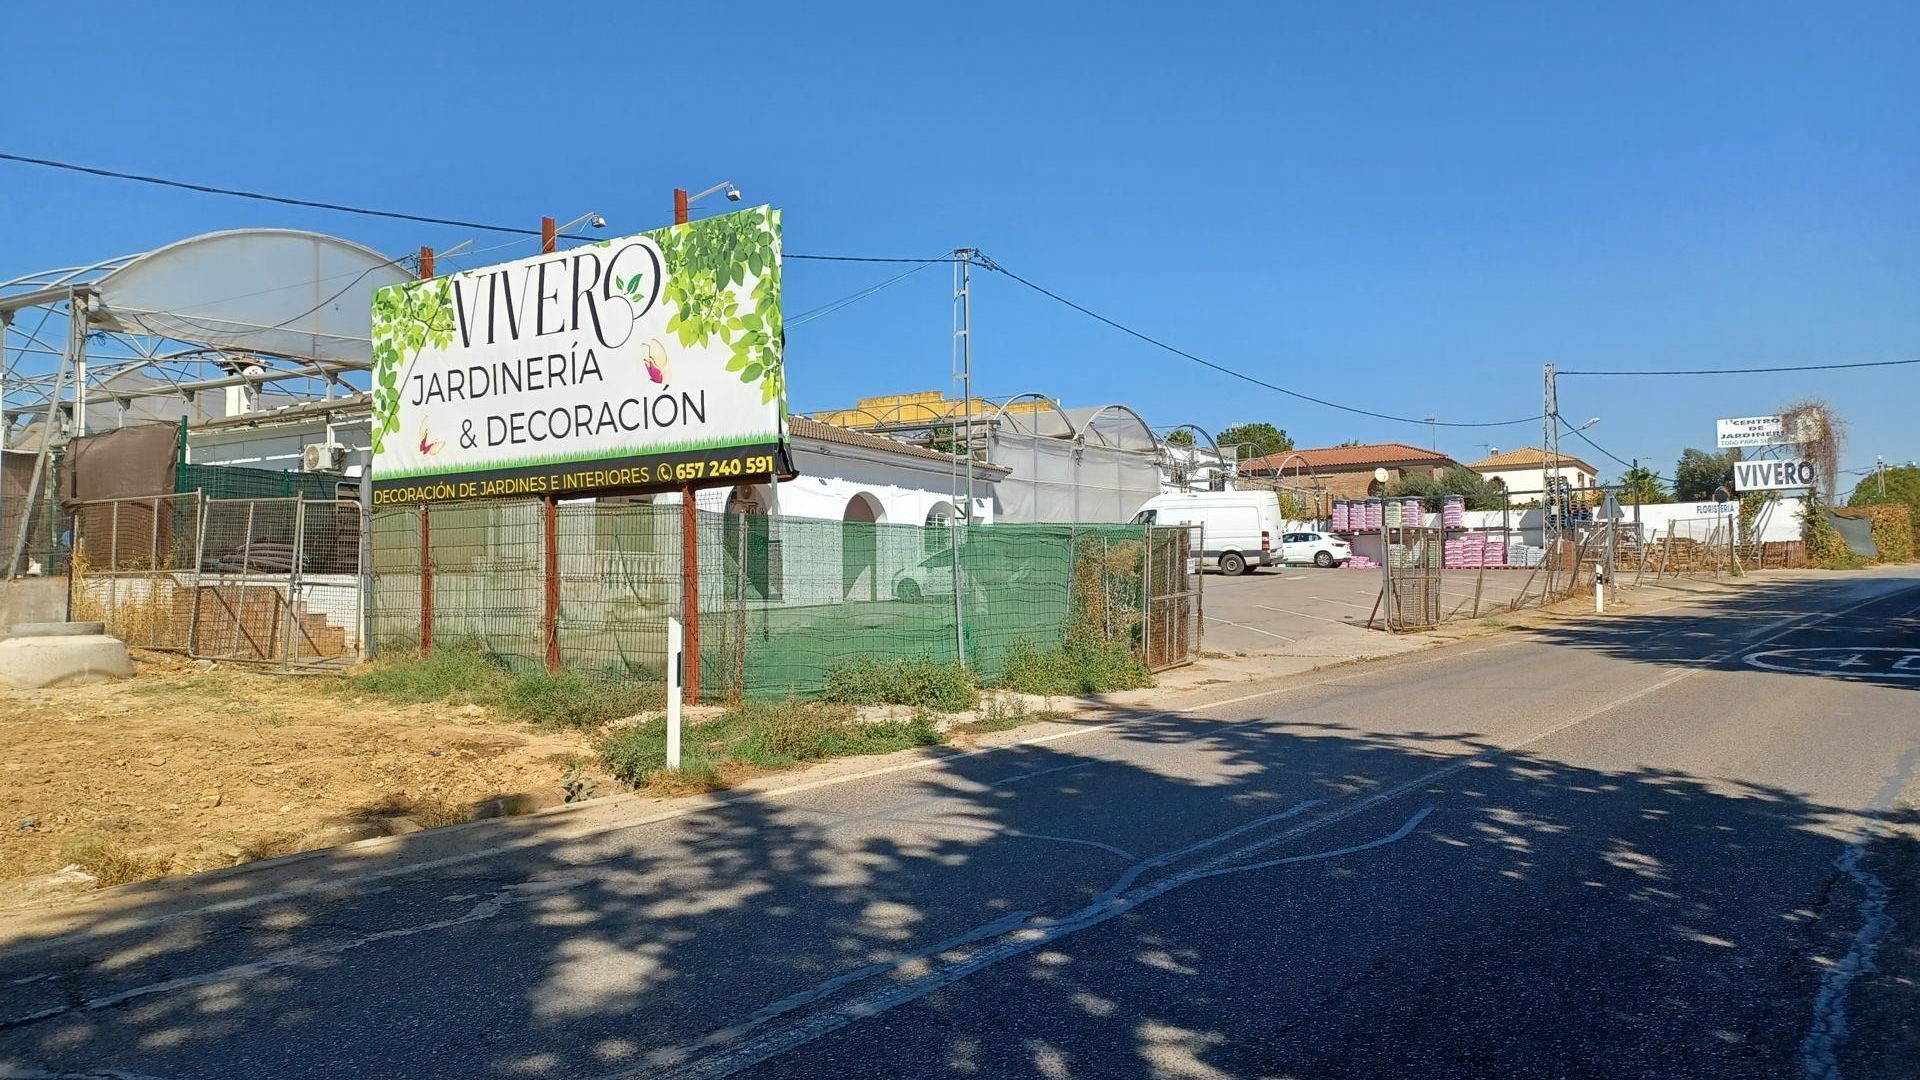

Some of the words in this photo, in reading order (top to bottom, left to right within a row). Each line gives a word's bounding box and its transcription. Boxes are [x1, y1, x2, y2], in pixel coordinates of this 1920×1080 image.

[453, 242, 662, 350] VIVERO
[411, 342, 604, 407] JARDINERÍA
[459, 418, 479, 450] &
[487, 385, 706, 448] DECORACIÓN
[373, 481, 455, 505] DECORACIÓN
[459, 482, 477, 498] DE
[480, 476, 547, 496] JARDINES
[551, 475, 559, 490] E
[562, 467, 650, 489] INTERIORES
[675, 462, 705, 480] 657
[709, 459, 741, 477] 240
[745, 456, 774, 474] 591
[1737, 461, 1815, 487] VIVERO
